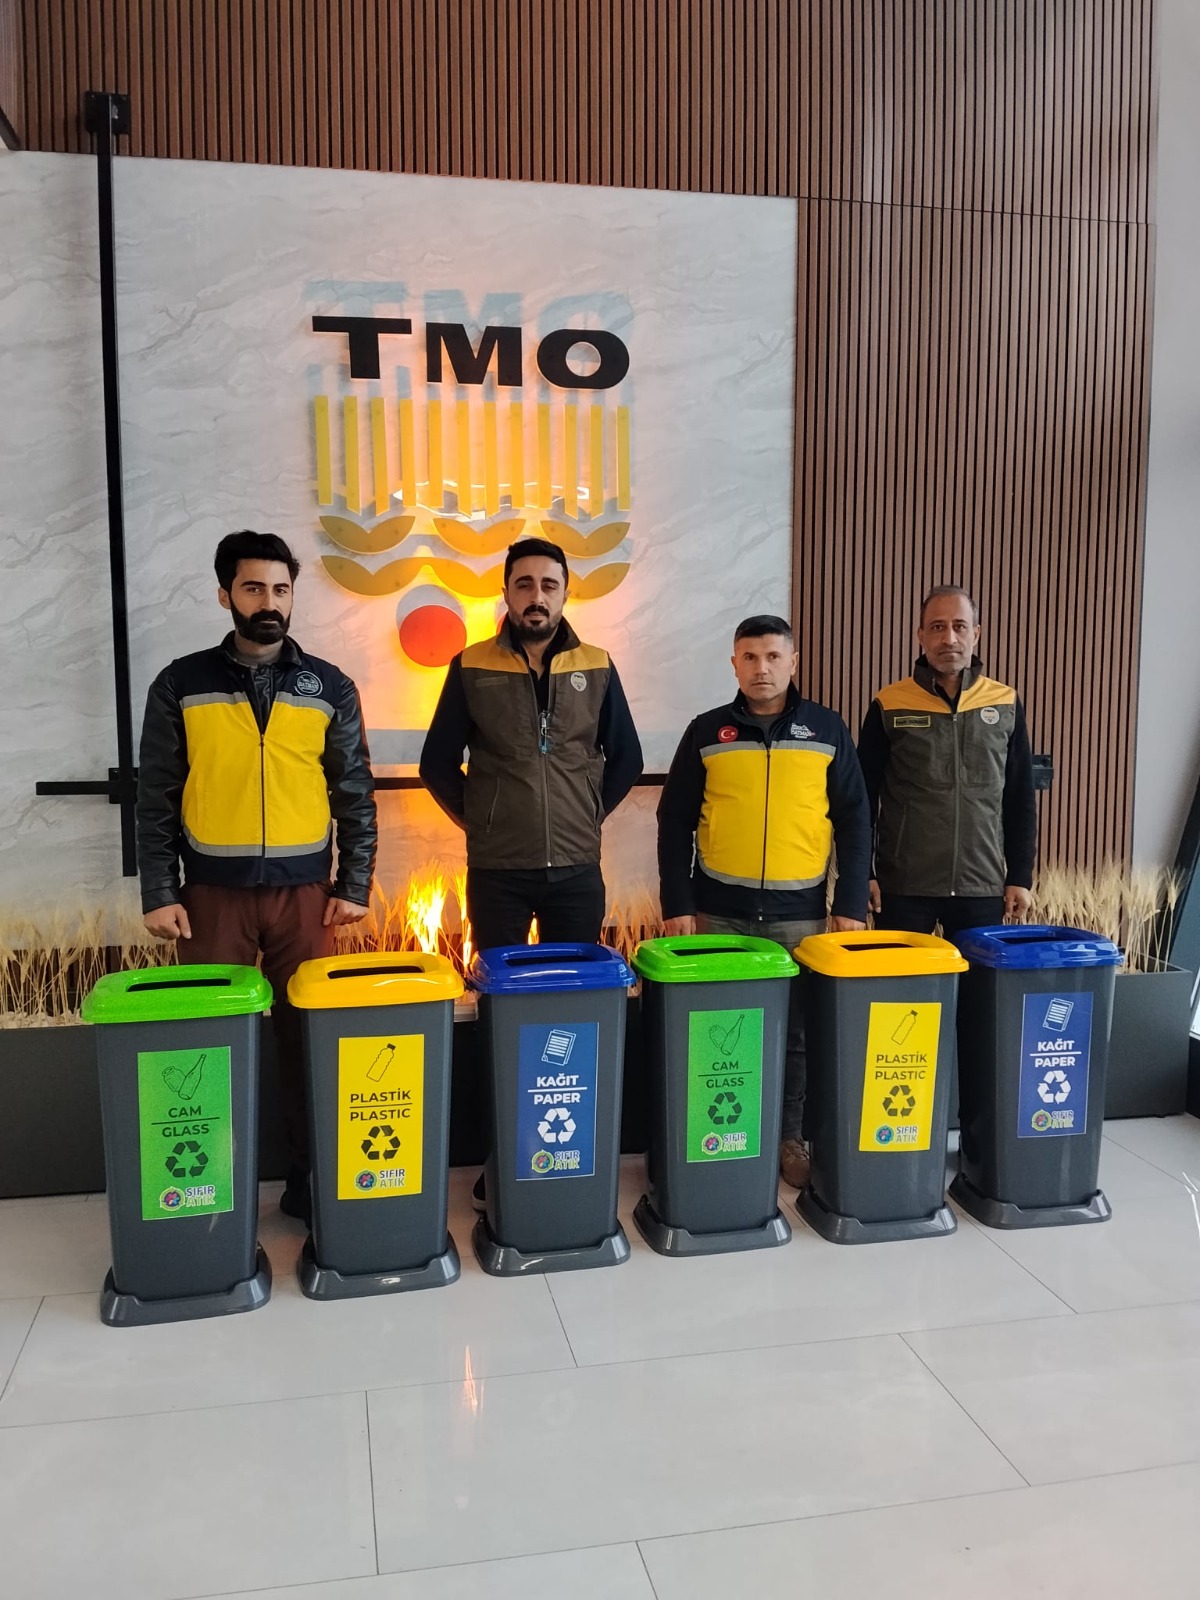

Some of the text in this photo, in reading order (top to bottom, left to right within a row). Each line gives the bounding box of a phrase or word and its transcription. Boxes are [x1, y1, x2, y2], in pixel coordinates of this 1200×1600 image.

[312, 316, 630, 389] TMO
[1037, 1038, 1075, 1052] KAĞIT
[876, 1051, 928, 1064] PLASTİK
[1034, 1057, 1076, 1068] PAPER
[711, 1060, 739, 1071] CAM
[536, 1073, 579, 1087] KAĞIT
[875, 1070, 926, 1080] PLASTIC
[705, 1077, 745, 1088] GLASS
[350, 1088, 412, 1103] PLASTİK
[533, 1092, 581, 1105] PAPER
[168, 1105, 202, 1118] CAM
[350, 1108, 411, 1121] PLASTIC
[162, 1123, 210, 1138] GLASS
[896, 1126, 918, 1134] SIFIR
[723, 1132, 747, 1142] SIFIR
[896, 1134, 917, 1143] ATIK
[554, 1150, 580, 1160] SIFIR
[554, 1159, 580, 1170] ATIK
[379, 1168, 405, 1178] SIFIR
[379, 1177, 405, 1188] ATIK
[185, 1185, 215, 1197] SIFIR
[185, 1195, 216, 1207] ATIK
